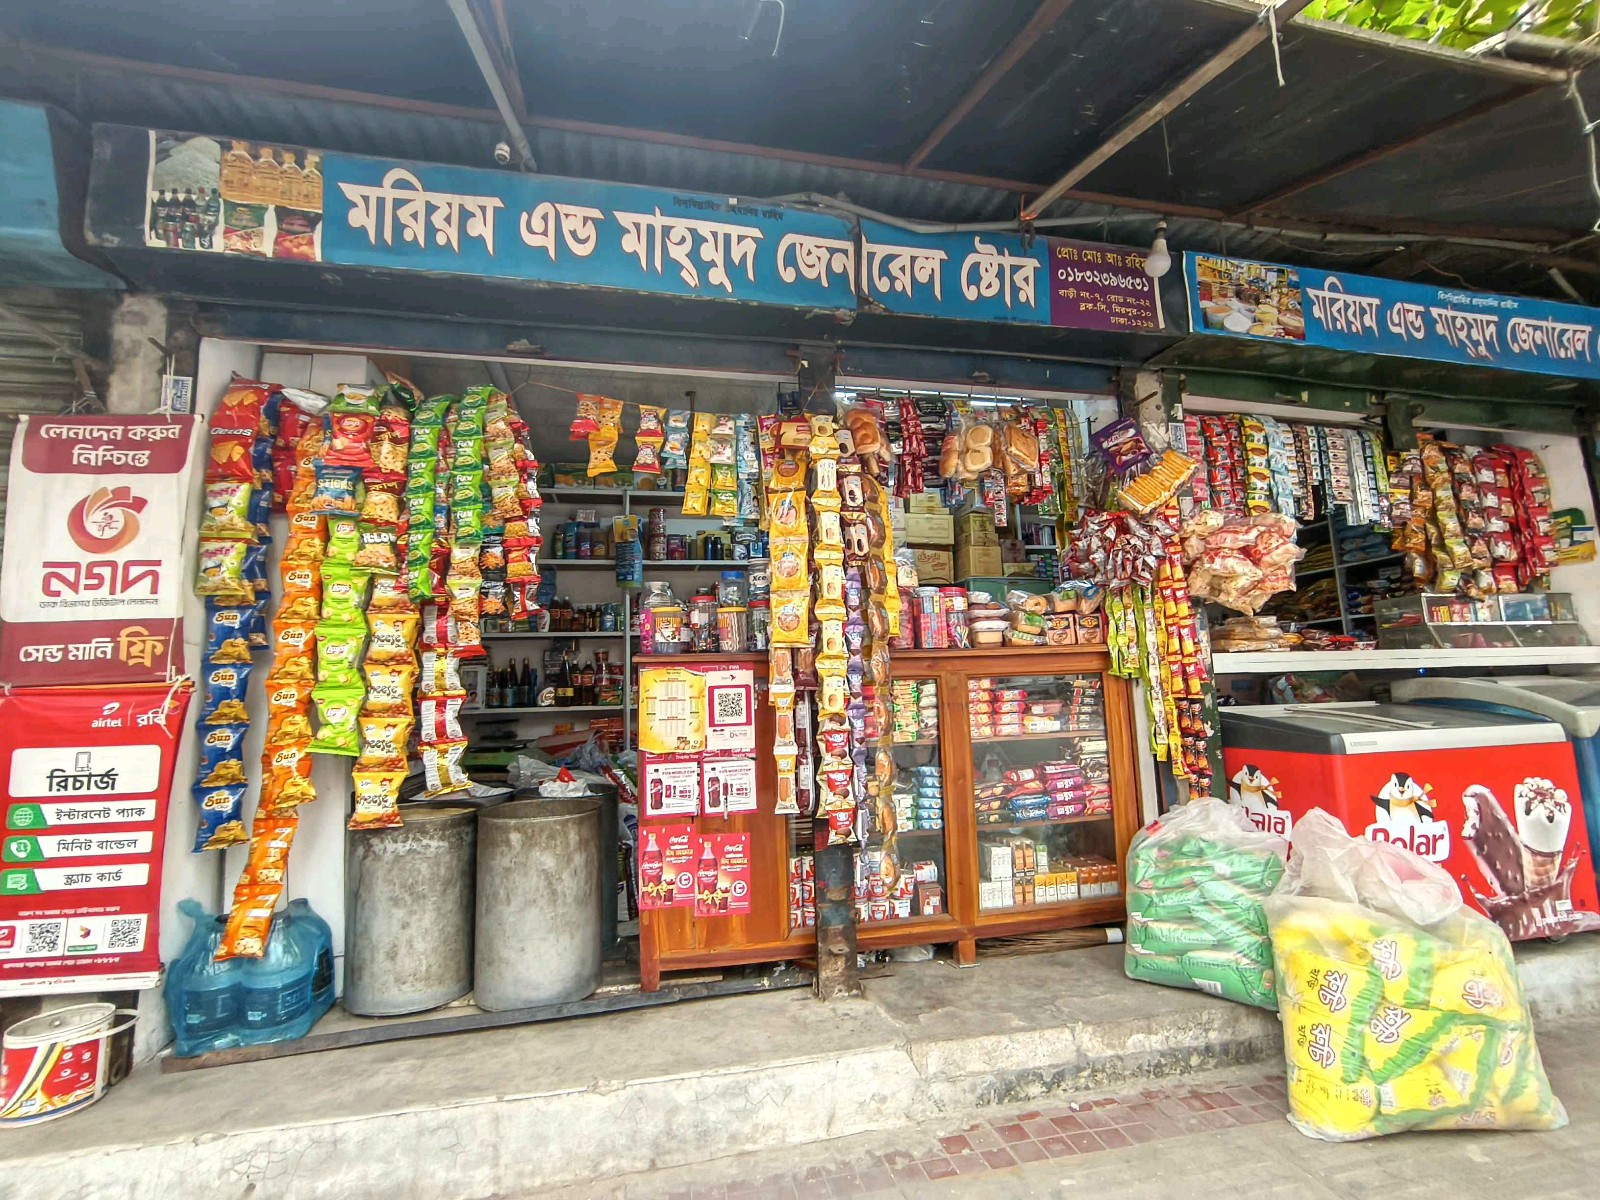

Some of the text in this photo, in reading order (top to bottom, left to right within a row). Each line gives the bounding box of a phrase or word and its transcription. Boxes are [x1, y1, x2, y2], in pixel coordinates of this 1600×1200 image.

[338, 168, 504, 255] মরিয়ম
[520, 202, 605, 261] এন্ড
[1306, 276, 1380, 343] মরিয়ম
[1507, 316, 1593, 363] জেনারেল
[40, 423, 183, 442] লেনদেন করুন
[72, 446, 151, 467] নিশ্চিন্তে
[295, 513, 316, 524] Sun
[42, 560, 163, 598] নগদ
[289, 571, 310, 581] Sun
[215, 612, 238, 622] Sun
[282, 630, 303, 641] Sun
[19, 625, 169, 668] সেন্ড মানি ফ্রি
[212, 672, 234, 683] Sun
[275, 691, 295, 702] Sun
[91, 717, 122, 728] airtel
[136, 709, 167, 727] রবি
[207, 732, 231, 744] Sun
[275, 752, 296, 764] Sun
[46, 767, 119, 792] রিচার্জ
[204, 794, 230, 807] Sun
[55, 806, 146, 821] ইন্টারনেট প্যাক
[57, 838, 138, 853] মিনিট বান্ডেল
[96, 868, 123, 882] কার্ড
[1318, 970, 1348, 1013] রুচি
[1308, 1023, 1335, 1069] রুচি
